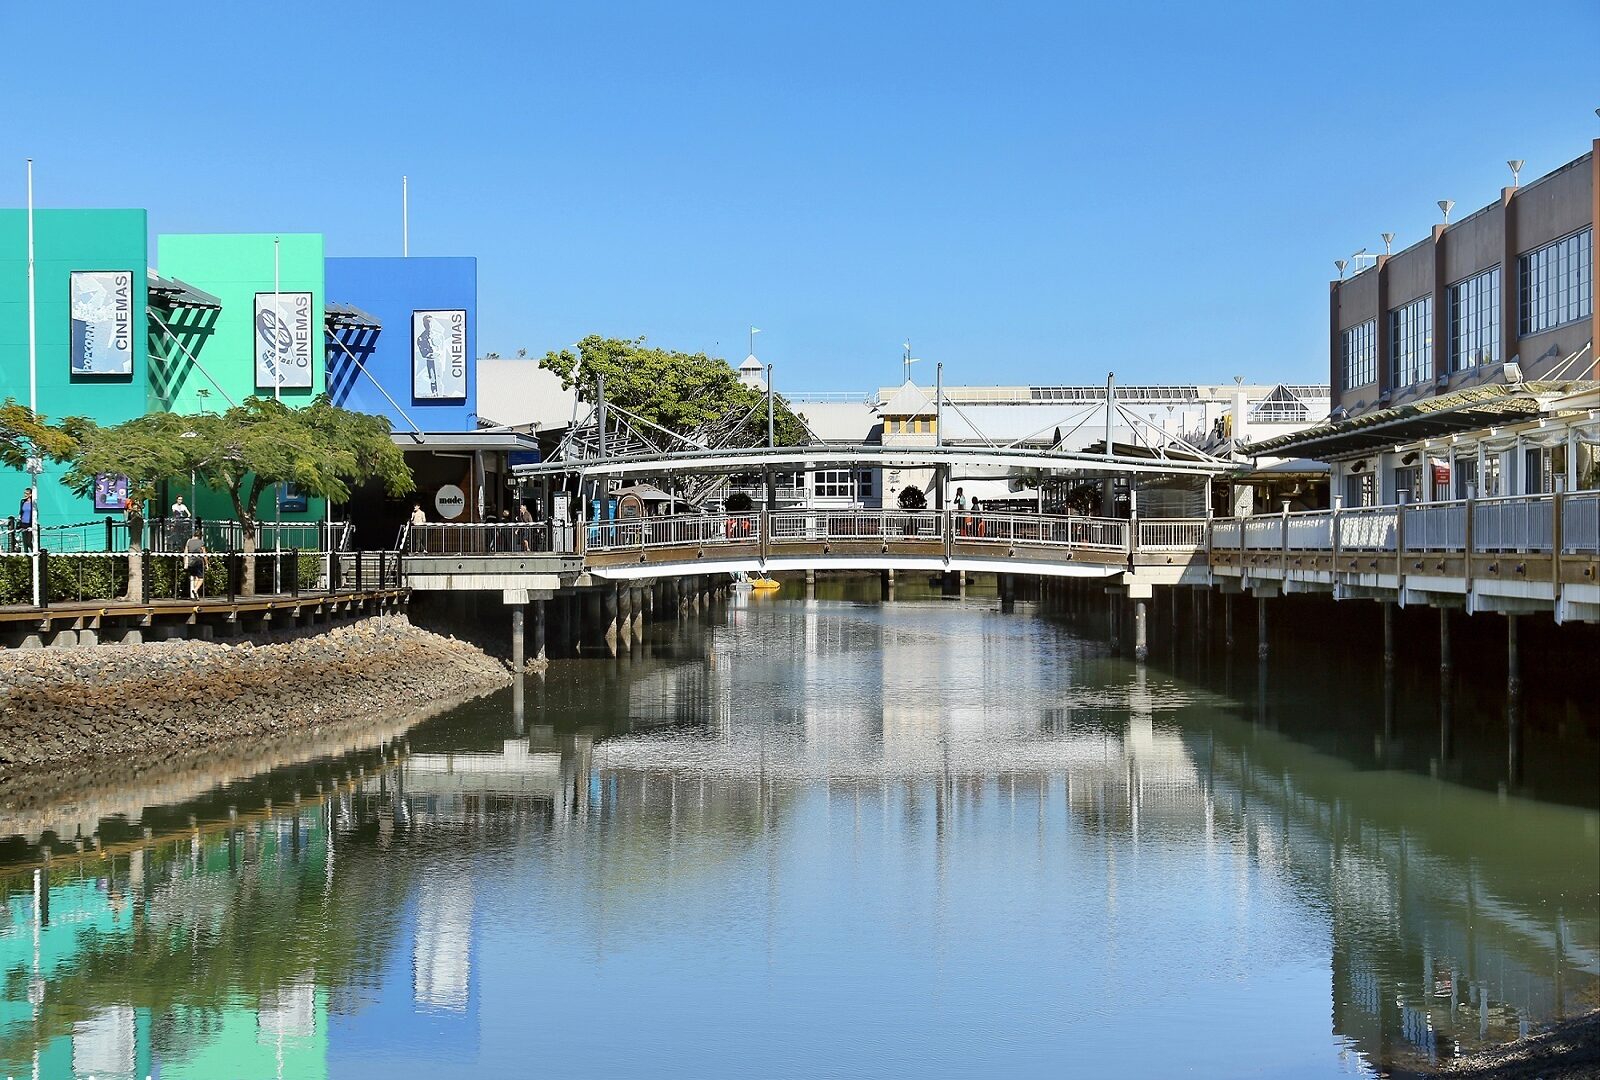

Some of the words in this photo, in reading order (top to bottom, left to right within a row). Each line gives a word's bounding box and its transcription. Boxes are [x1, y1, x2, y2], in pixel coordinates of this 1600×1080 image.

[83, 321, 95, 373] POPCORN
[115, 275, 128, 351] CINEMAS
[296, 296, 308, 368] CINEMAS
[451, 313, 463, 378] CINEMAS
